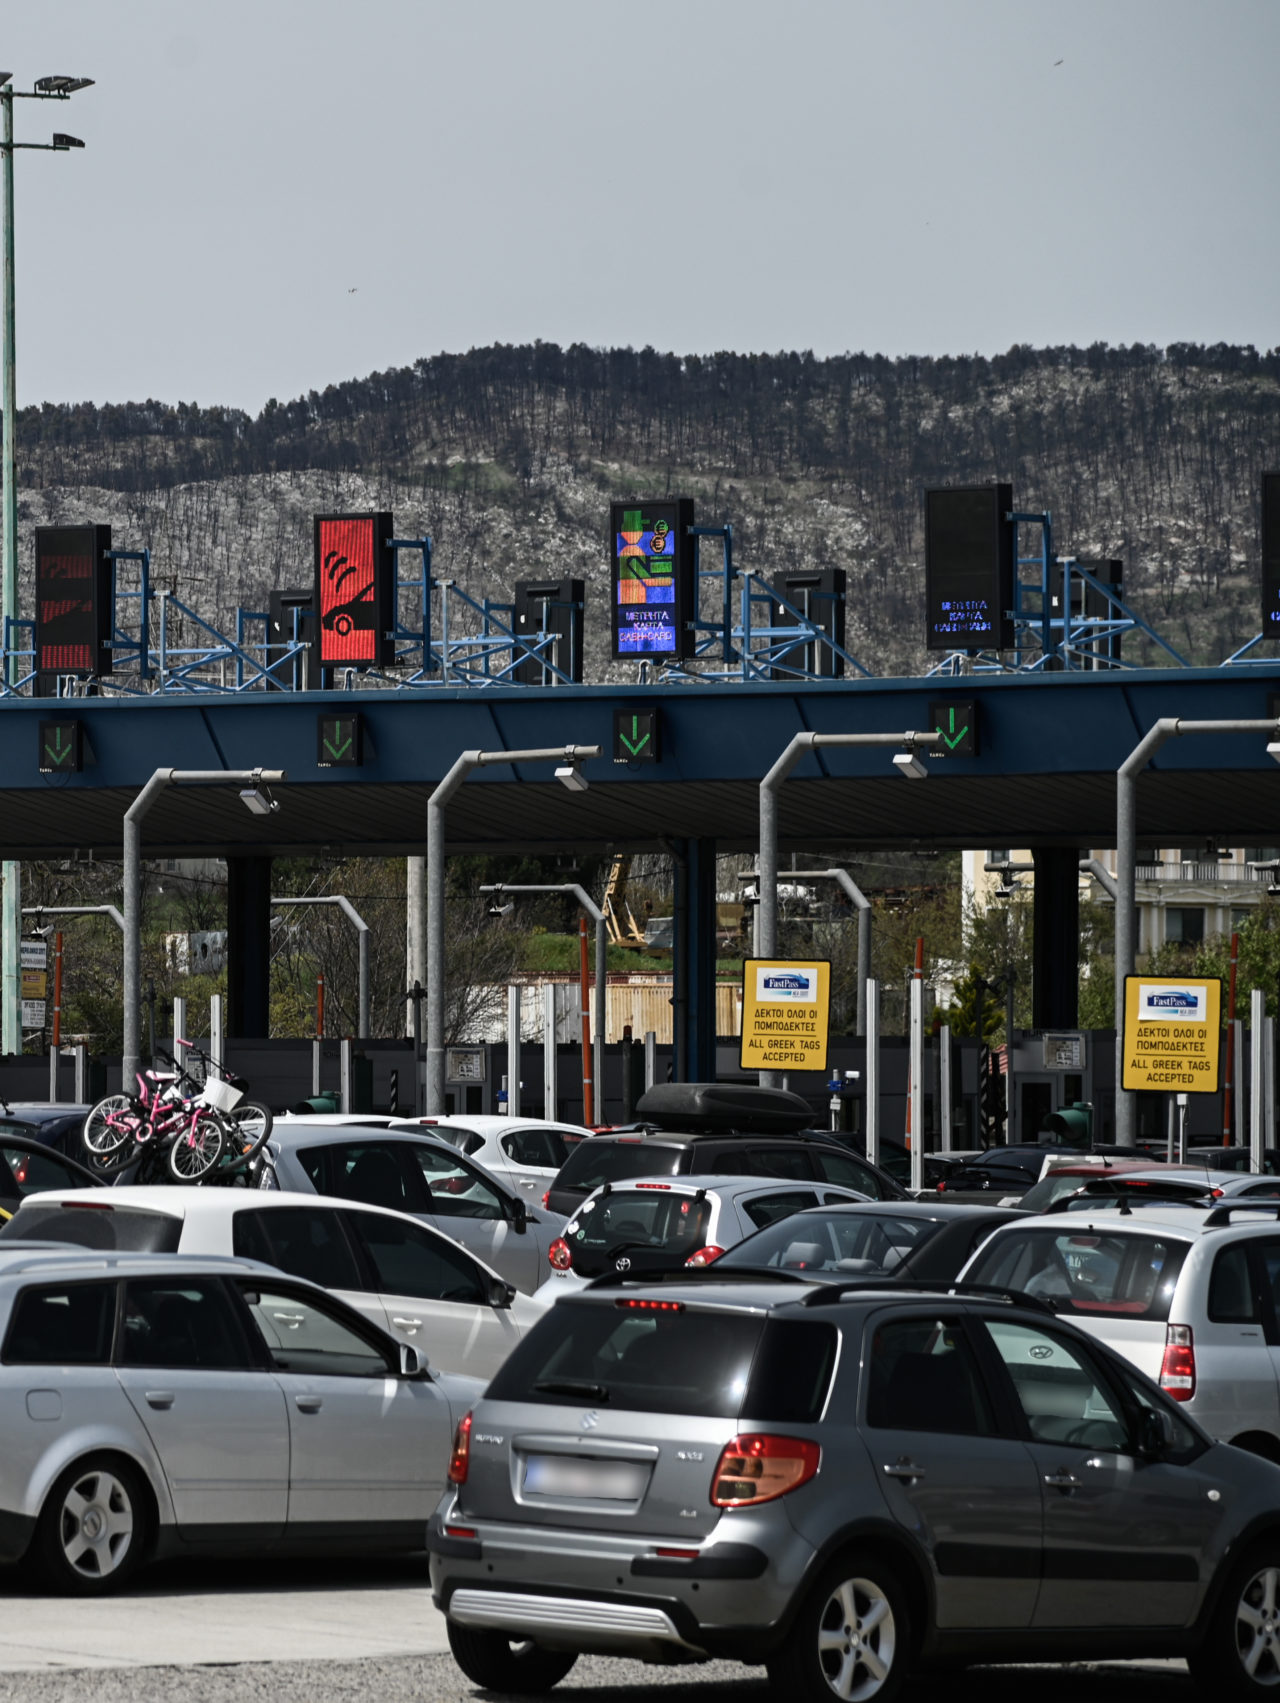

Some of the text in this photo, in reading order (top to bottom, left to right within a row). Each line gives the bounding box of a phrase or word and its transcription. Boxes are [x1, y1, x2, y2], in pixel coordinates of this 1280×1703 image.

[769, 979, 799, 988] FastPass
[1153, 997, 1186, 1006] FastPass
[754, 1008, 818, 1019] ΔΕΚΤΟΙ ΟΛΟΙ ΟΙ
[754, 1020, 816, 1032] ΠΟΜΠΟΔΕΚΤΕΣ
[1136, 1027, 1207, 1039] ΔΕΚΤΟΙ ΟΛΟΙ ΟΙ
[748, 1039, 764, 1049] ALL
[767, 1039, 796, 1049] GREEK
[800, 1040, 821, 1050] TAGS
[1136, 1041, 1206, 1052] ΠΟΜΠΟΔΕΚΤΕΣ
[762, 1052, 806, 1062] ACCEPTED
[1130, 1059, 1211, 1071] ALL GREEK TAGS
[1146, 1072, 1194, 1084] ACCEPTED
